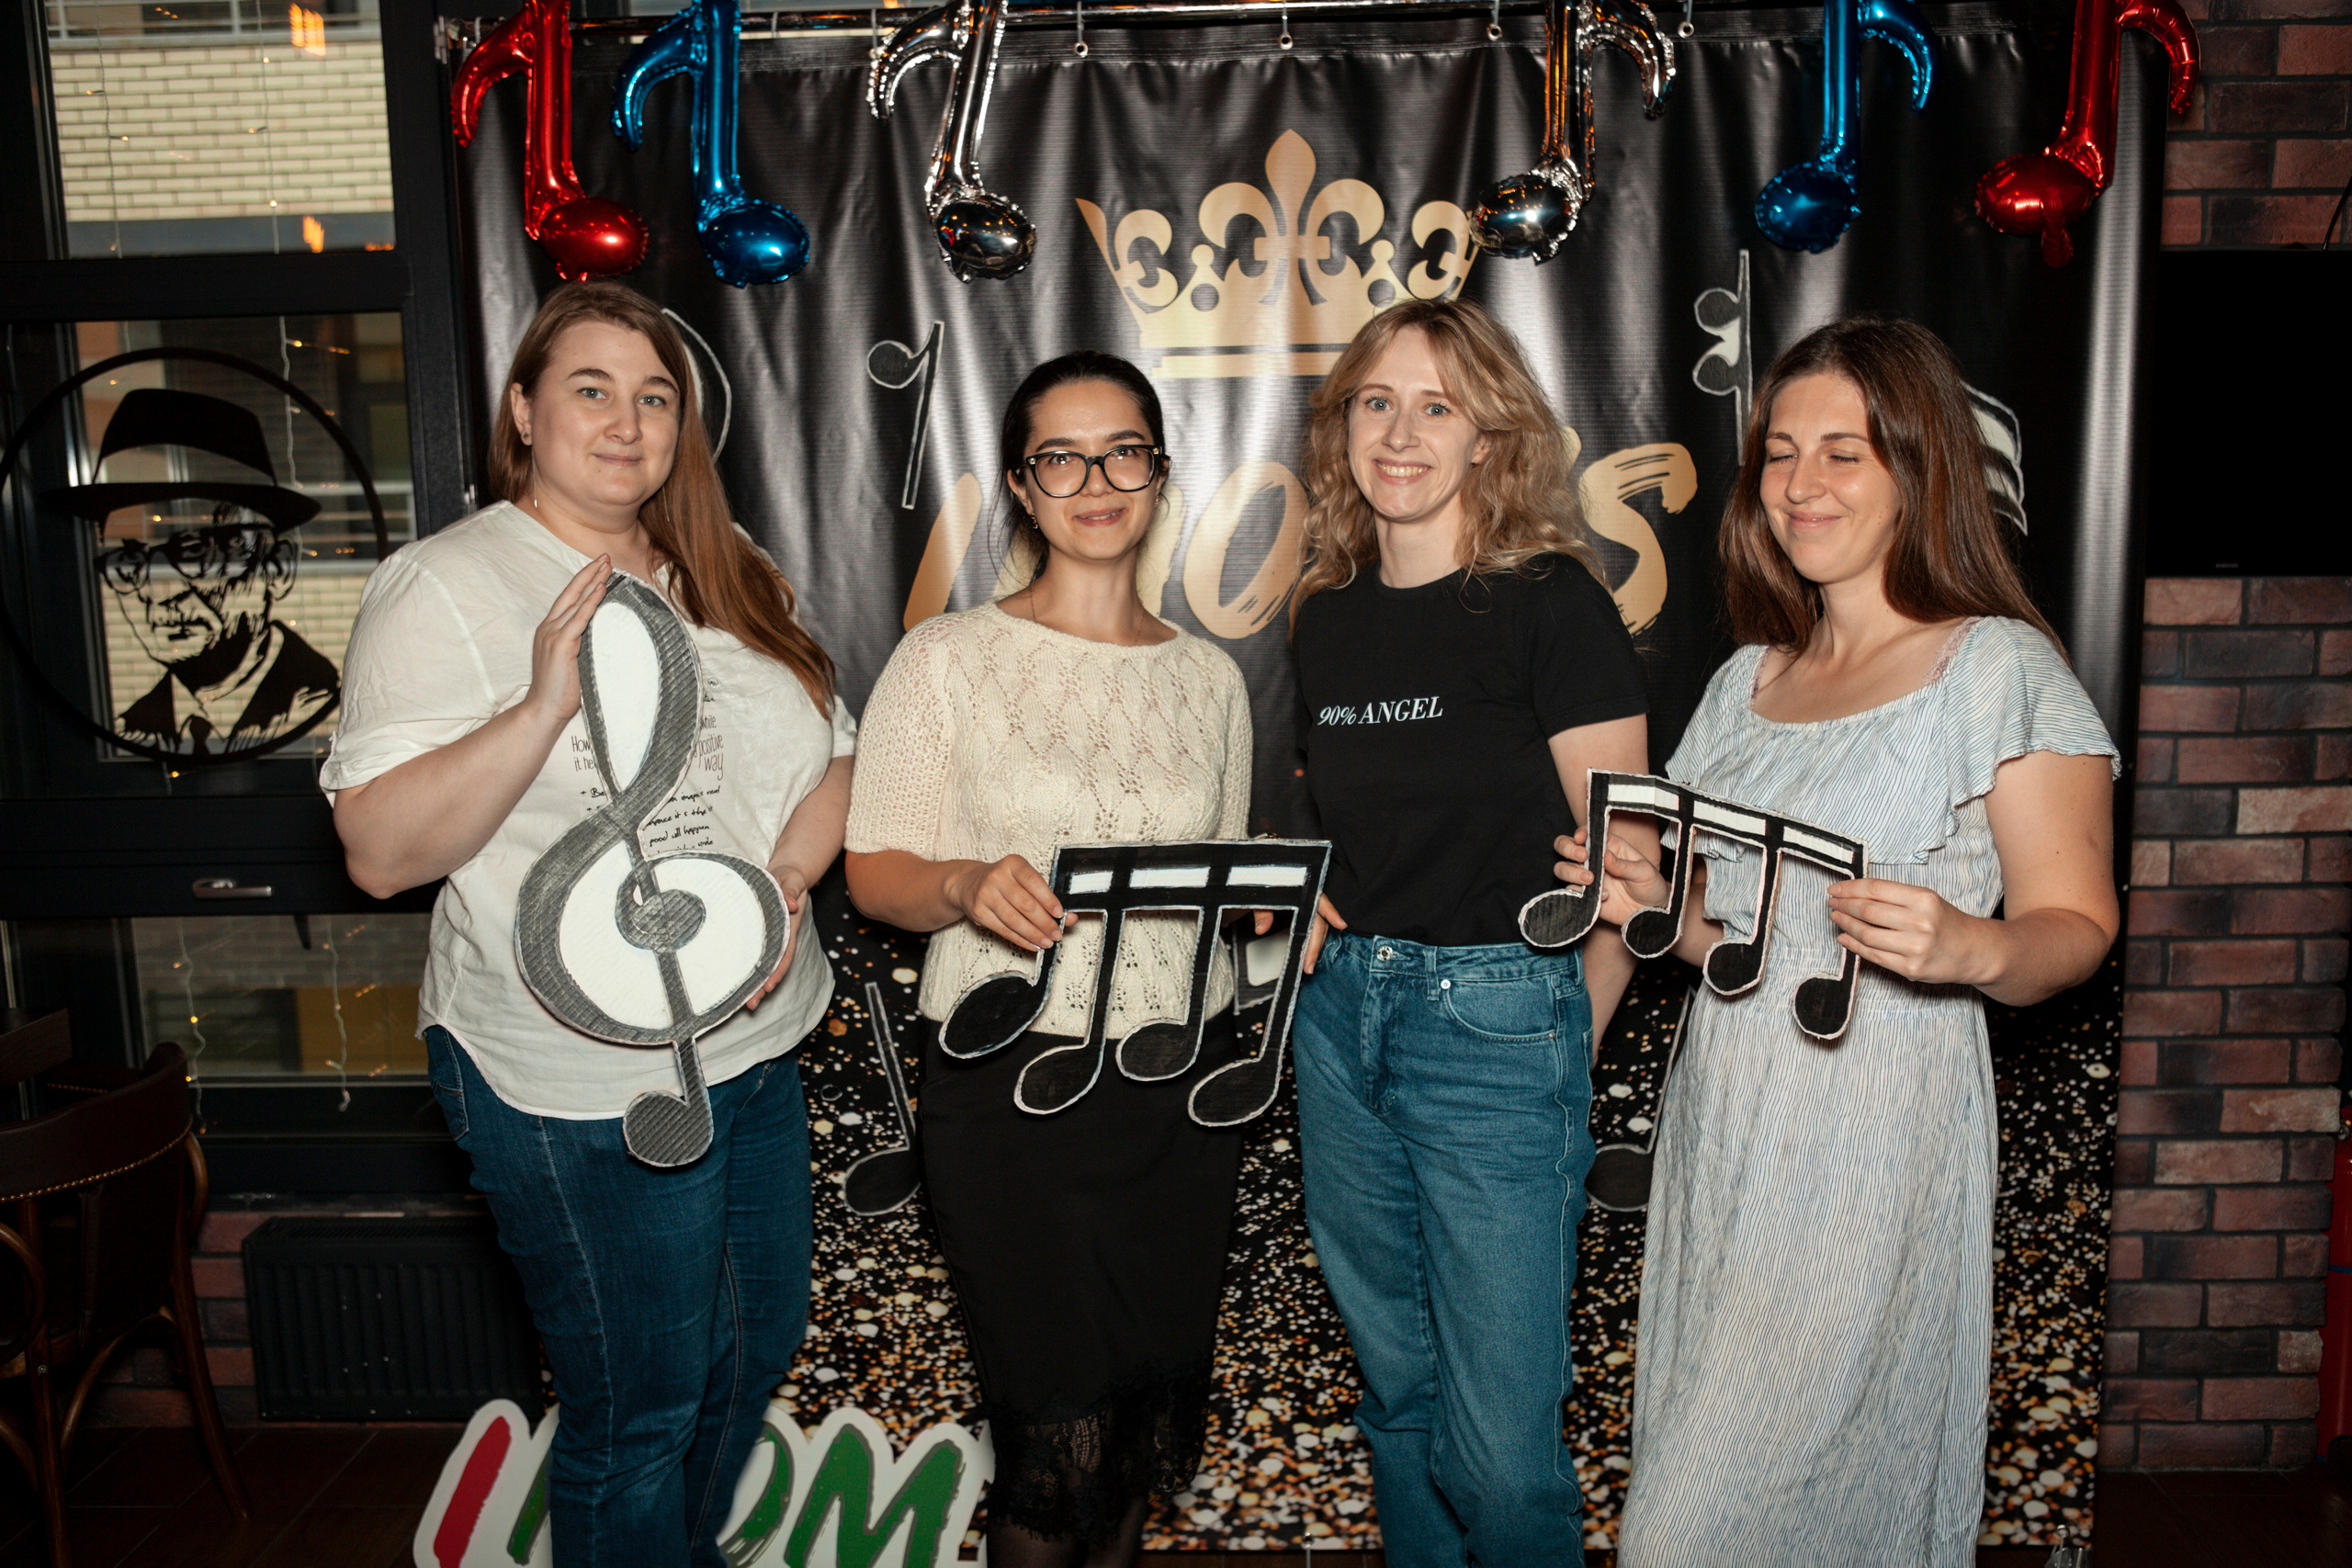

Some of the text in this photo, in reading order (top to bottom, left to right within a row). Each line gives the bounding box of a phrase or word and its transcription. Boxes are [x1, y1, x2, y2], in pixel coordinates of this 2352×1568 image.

[1317, 695, 1443, 726] 90% ANGEL
[571, 735, 591, 752] How
[698, 734, 724, 769] positive
[573, 756, 582, 773] it
[704, 752, 724, 781] way
